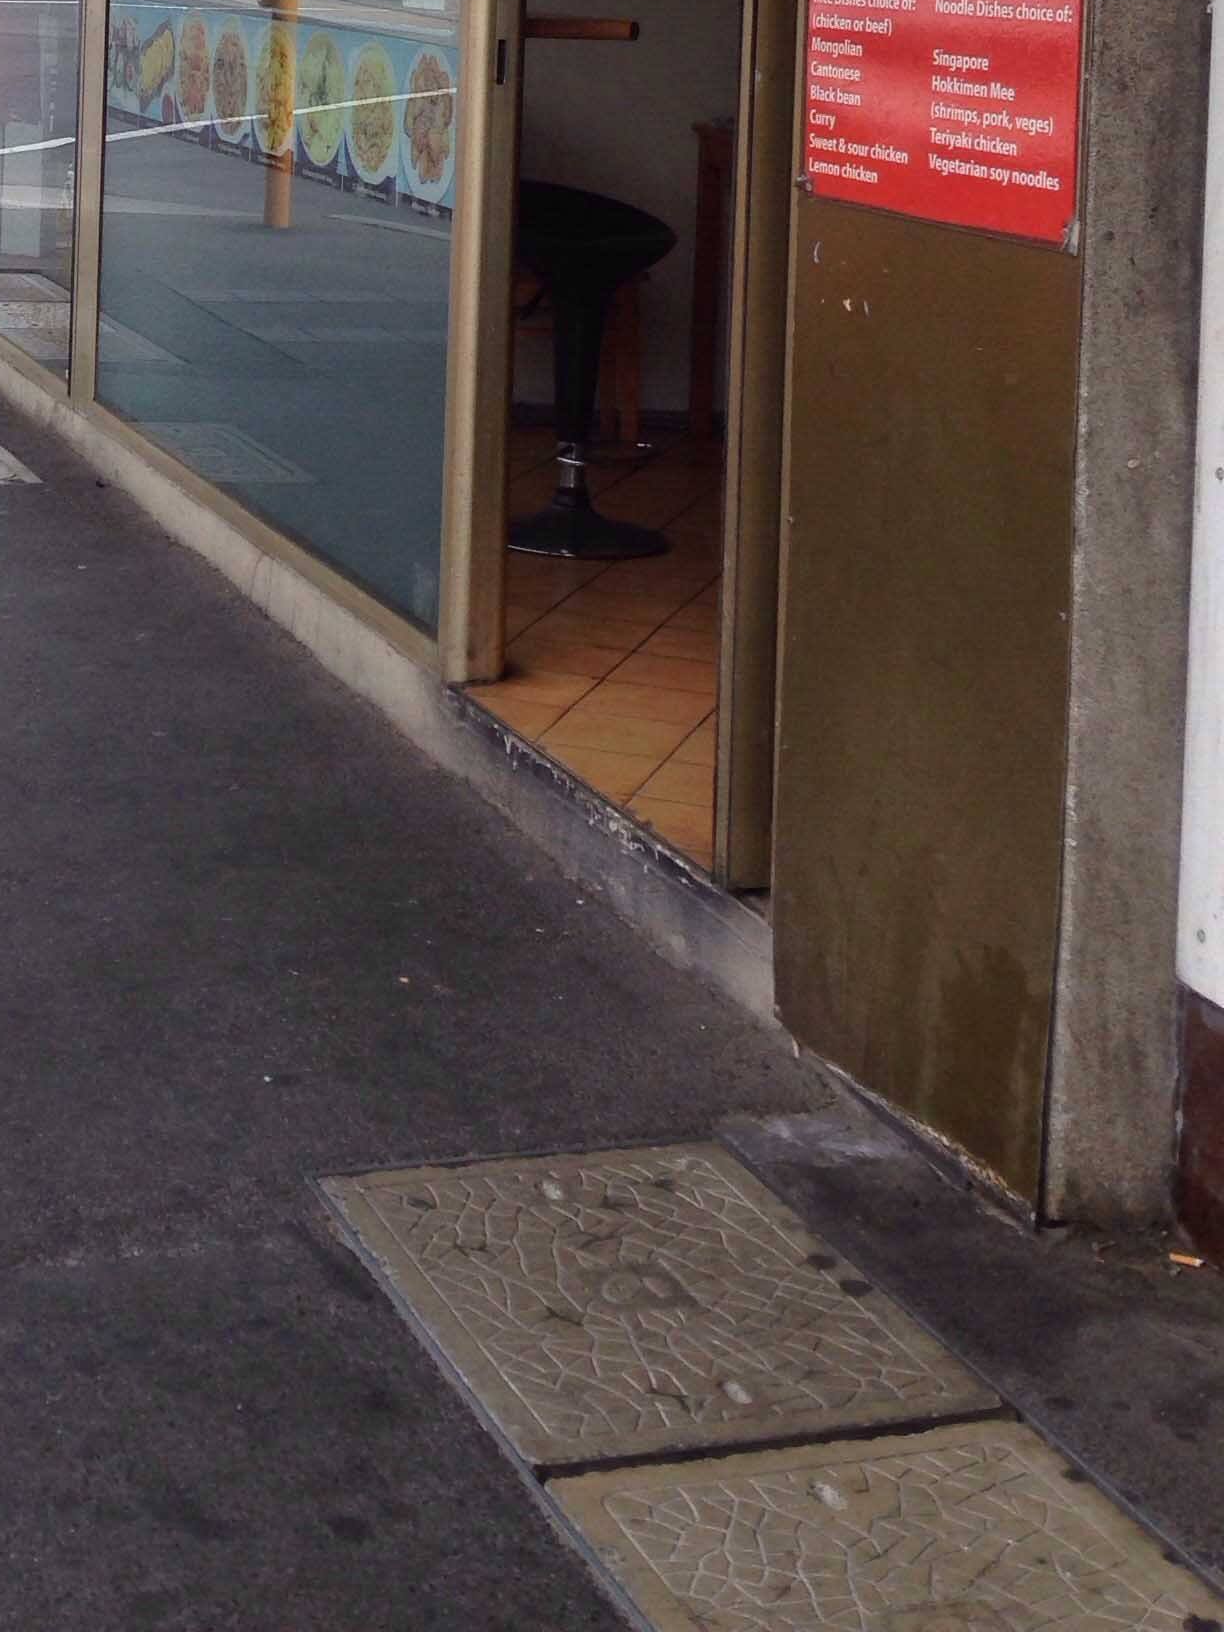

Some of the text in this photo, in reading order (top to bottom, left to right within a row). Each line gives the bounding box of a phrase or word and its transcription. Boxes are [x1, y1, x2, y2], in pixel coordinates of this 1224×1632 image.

[976, 0, 1014, 19] Dishes
[1016, 2, 1054, 22] choice
[1056, 4, 1073, 23] of:
[812, 14, 893, 37] (chicken or beef)
[811, 36, 863, 58] Mongolian
[811, 60, 861, 82] Cantonese
[932, 48, 989, 71] Singapore
[810, 84, 861, 106] Black bean
[931, 75, 1016, 101] Hokkimen Mee
[810, 109, 836, 130] Curry
[983, 108, 1013, 130] pork,
[1015, 115, 1054, 137] veges)
[809, 133, 909, 164] Sweet & sour chicken
[929, 127, 1017, 157] Teriyaki chicken
[809, 156, 878, 184] Lemon chicken
[928, 153, 1060, 191] Vegetarian soy noodles
